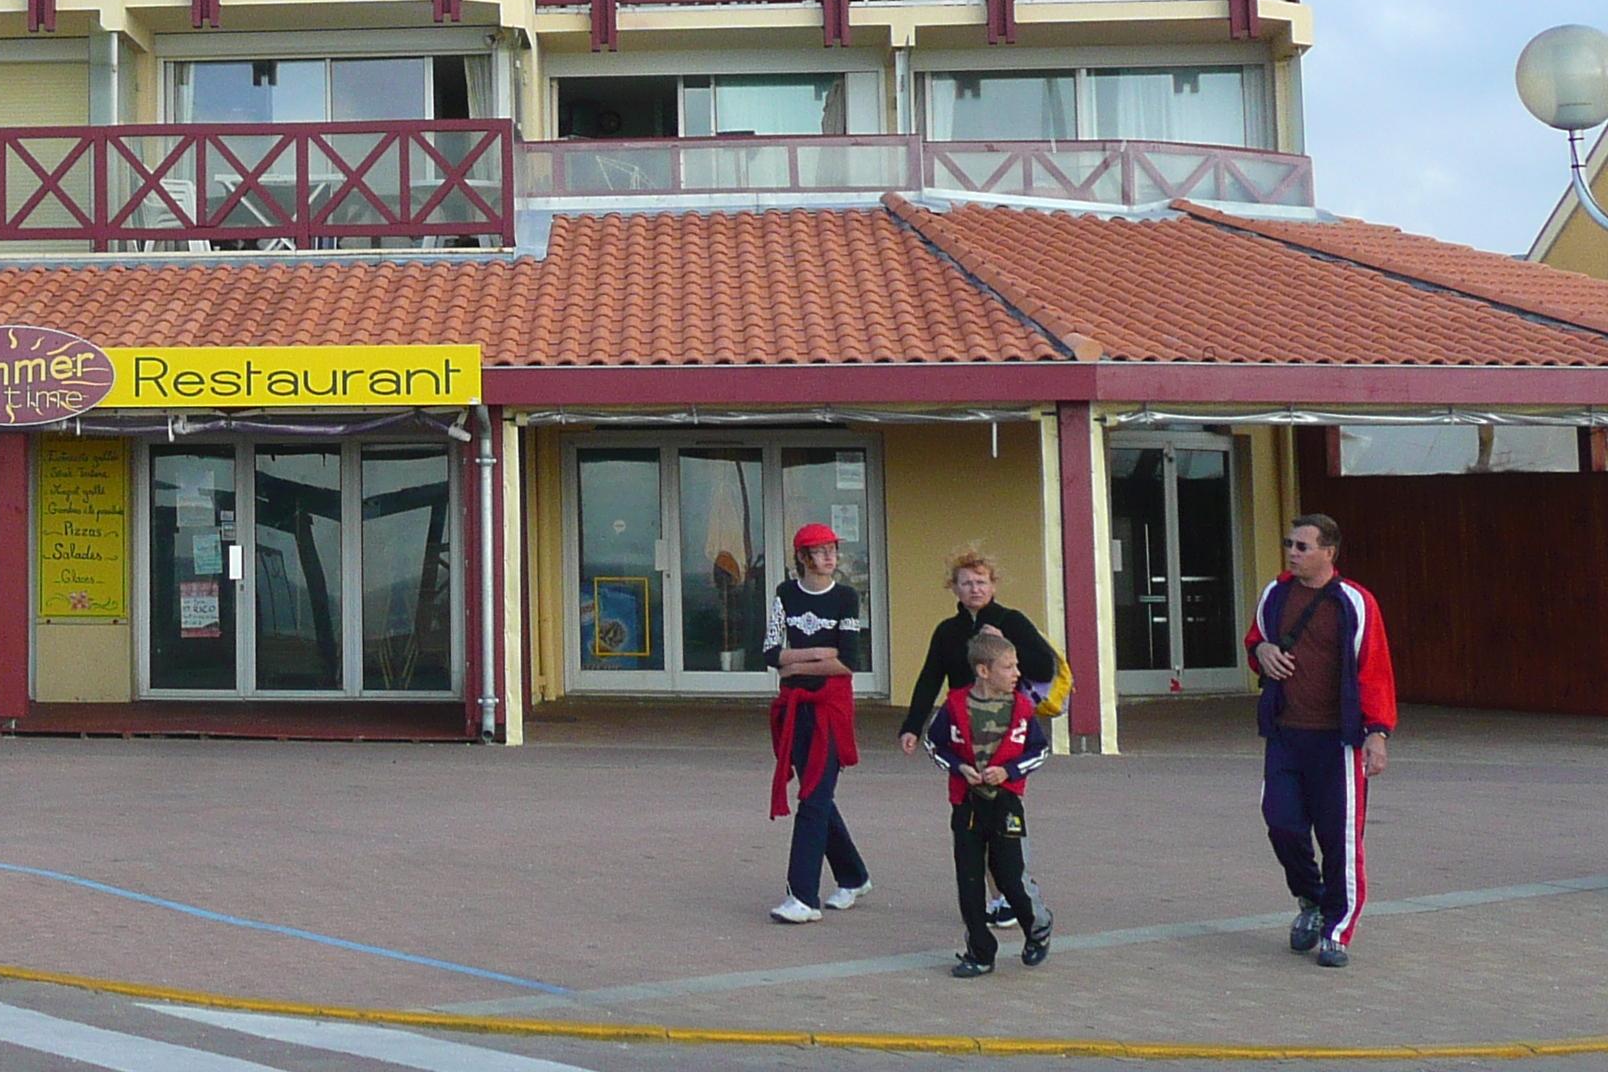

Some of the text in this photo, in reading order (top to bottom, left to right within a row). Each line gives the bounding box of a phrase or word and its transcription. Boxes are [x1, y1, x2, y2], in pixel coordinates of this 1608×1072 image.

[134, 357, 462, 398] Restaurant
[4, 385, 83, 409] time
[64, 521, 103, 538] Pizzas
[52, 542, 103, 561] Salades
[61, 568, 95, 584] Glaces
